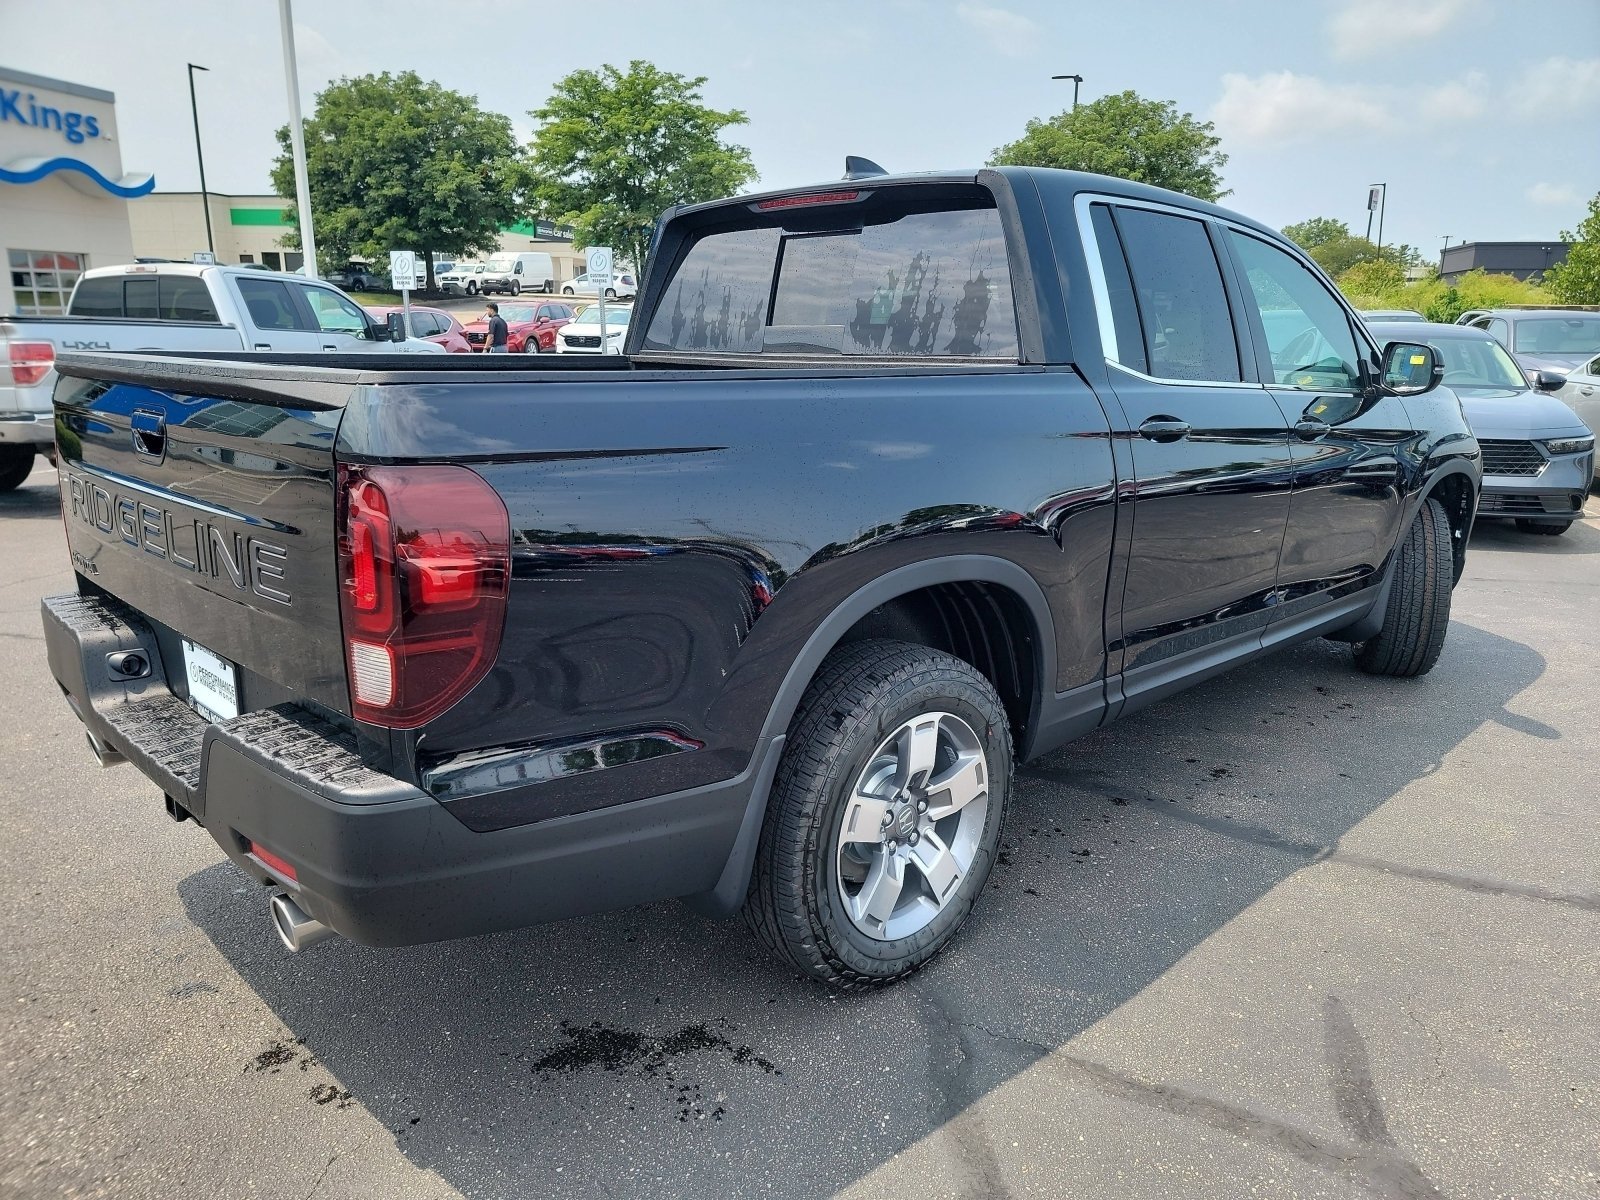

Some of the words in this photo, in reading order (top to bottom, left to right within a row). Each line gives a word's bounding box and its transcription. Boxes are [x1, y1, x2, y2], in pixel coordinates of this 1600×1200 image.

[0, 87, 100, 144] Kings
[69, 473, 293, 607] RIDGELINE
[198, 665, 235, 698] PERFORMANCE
